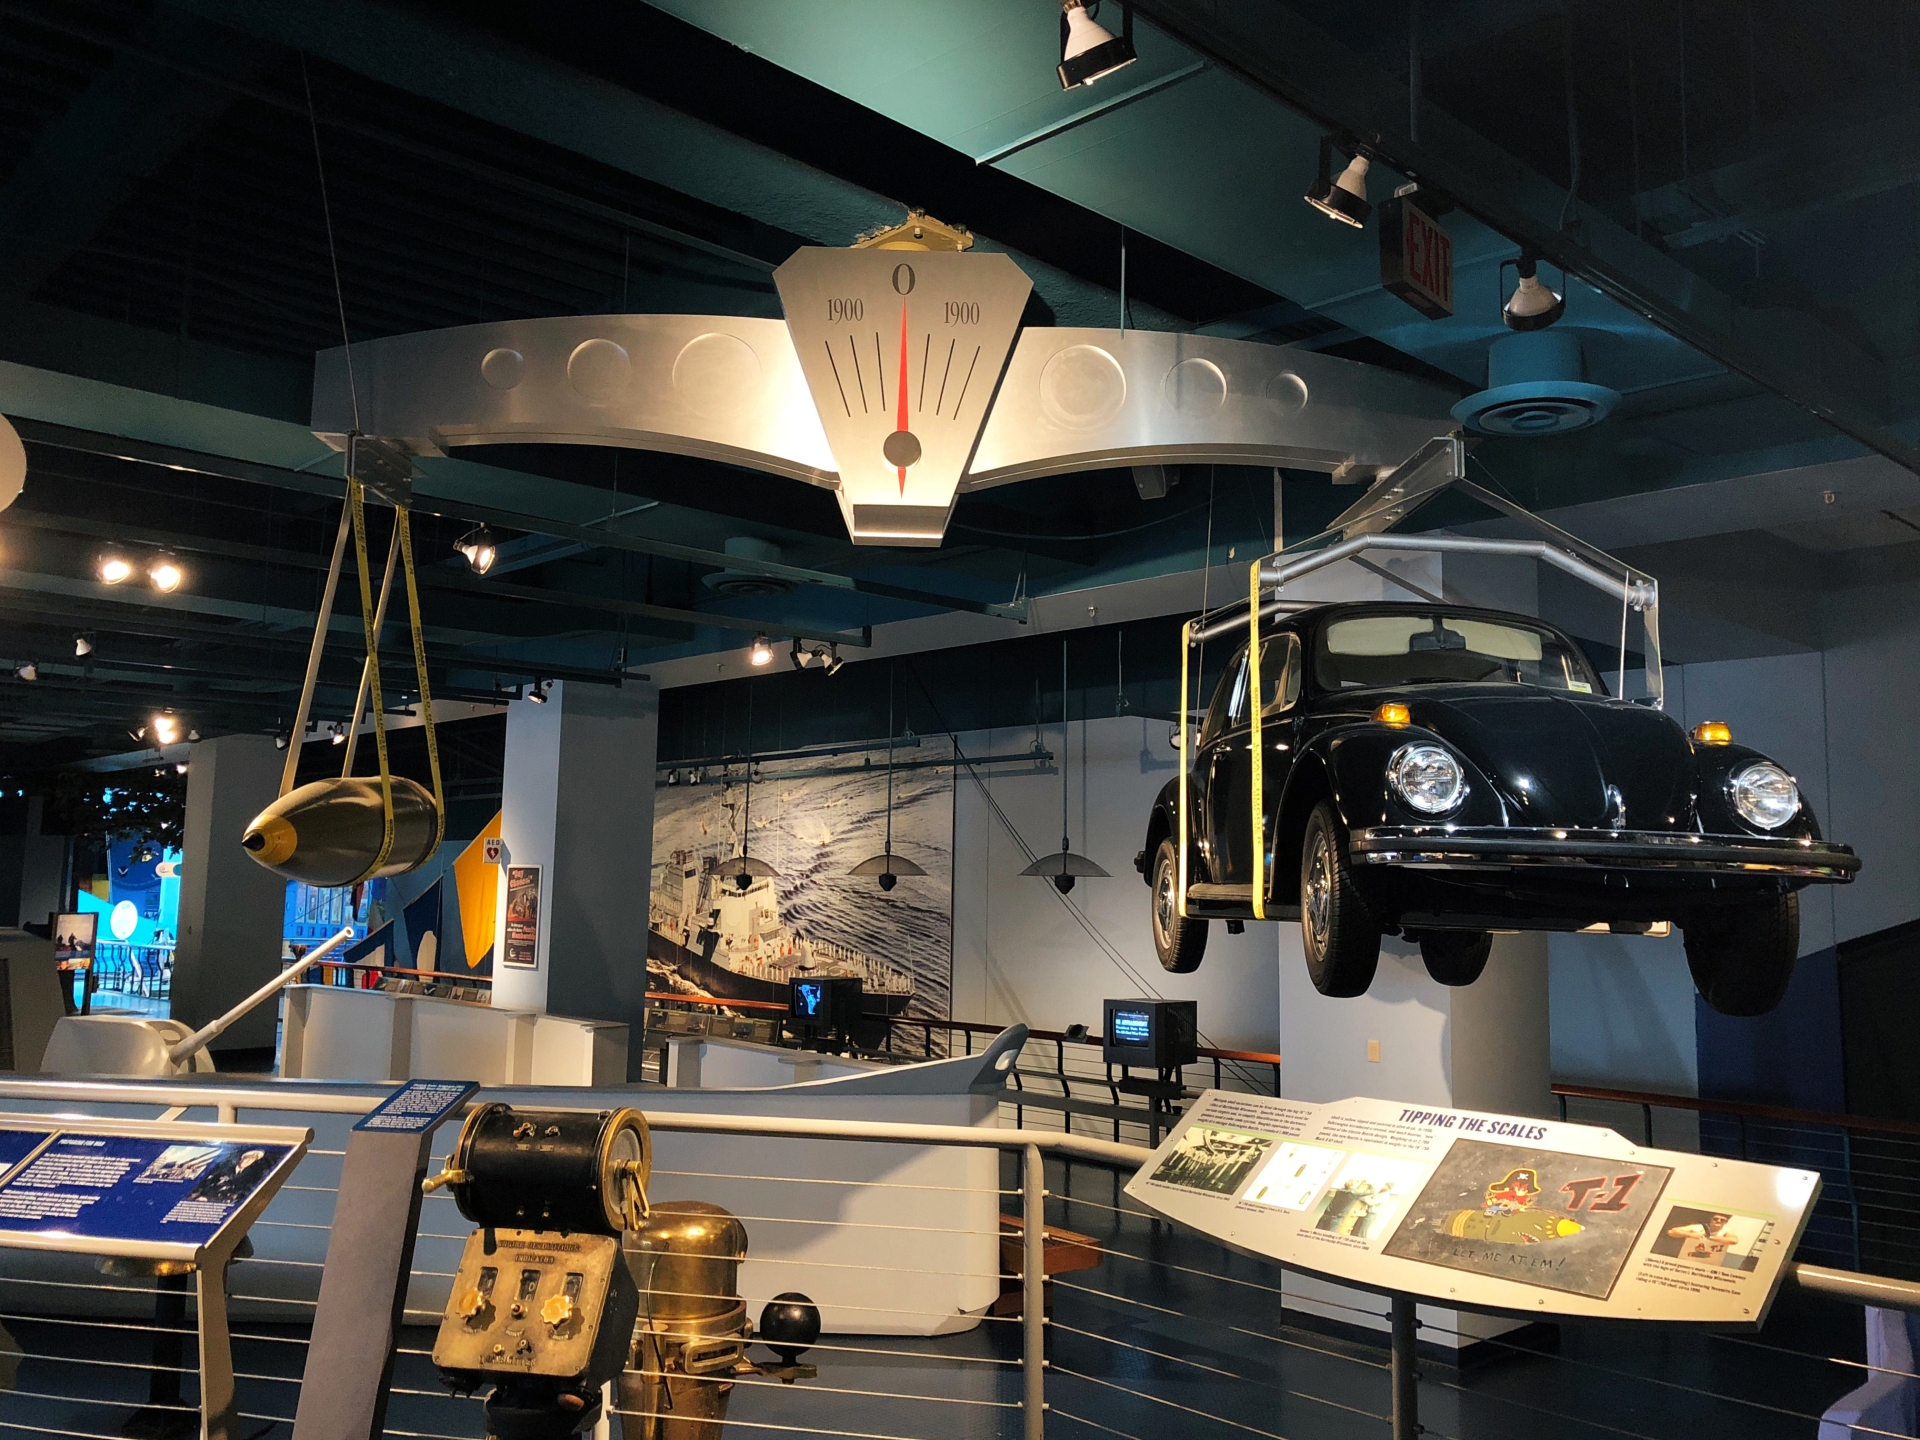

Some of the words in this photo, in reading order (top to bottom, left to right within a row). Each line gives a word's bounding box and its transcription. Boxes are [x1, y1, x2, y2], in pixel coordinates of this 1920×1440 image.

[1408, 212, 1450, 302] EXIT
[827, 298, 864, 325] 1900
[944, 301, 980, 326] 1900
[1398, 1109, 1457, 1128] TIPPING
[1458, 1117, 1488, 1132] THE
[1487, 1121, 1548, 1140] SCALES
[1558, 1174, 1642, 1212] T-1
[1453, 1247, 1475, 1258] LET
[1482, 1252, 1501, 1262] ME
[1508, 1254, 1527, 1265] AT
